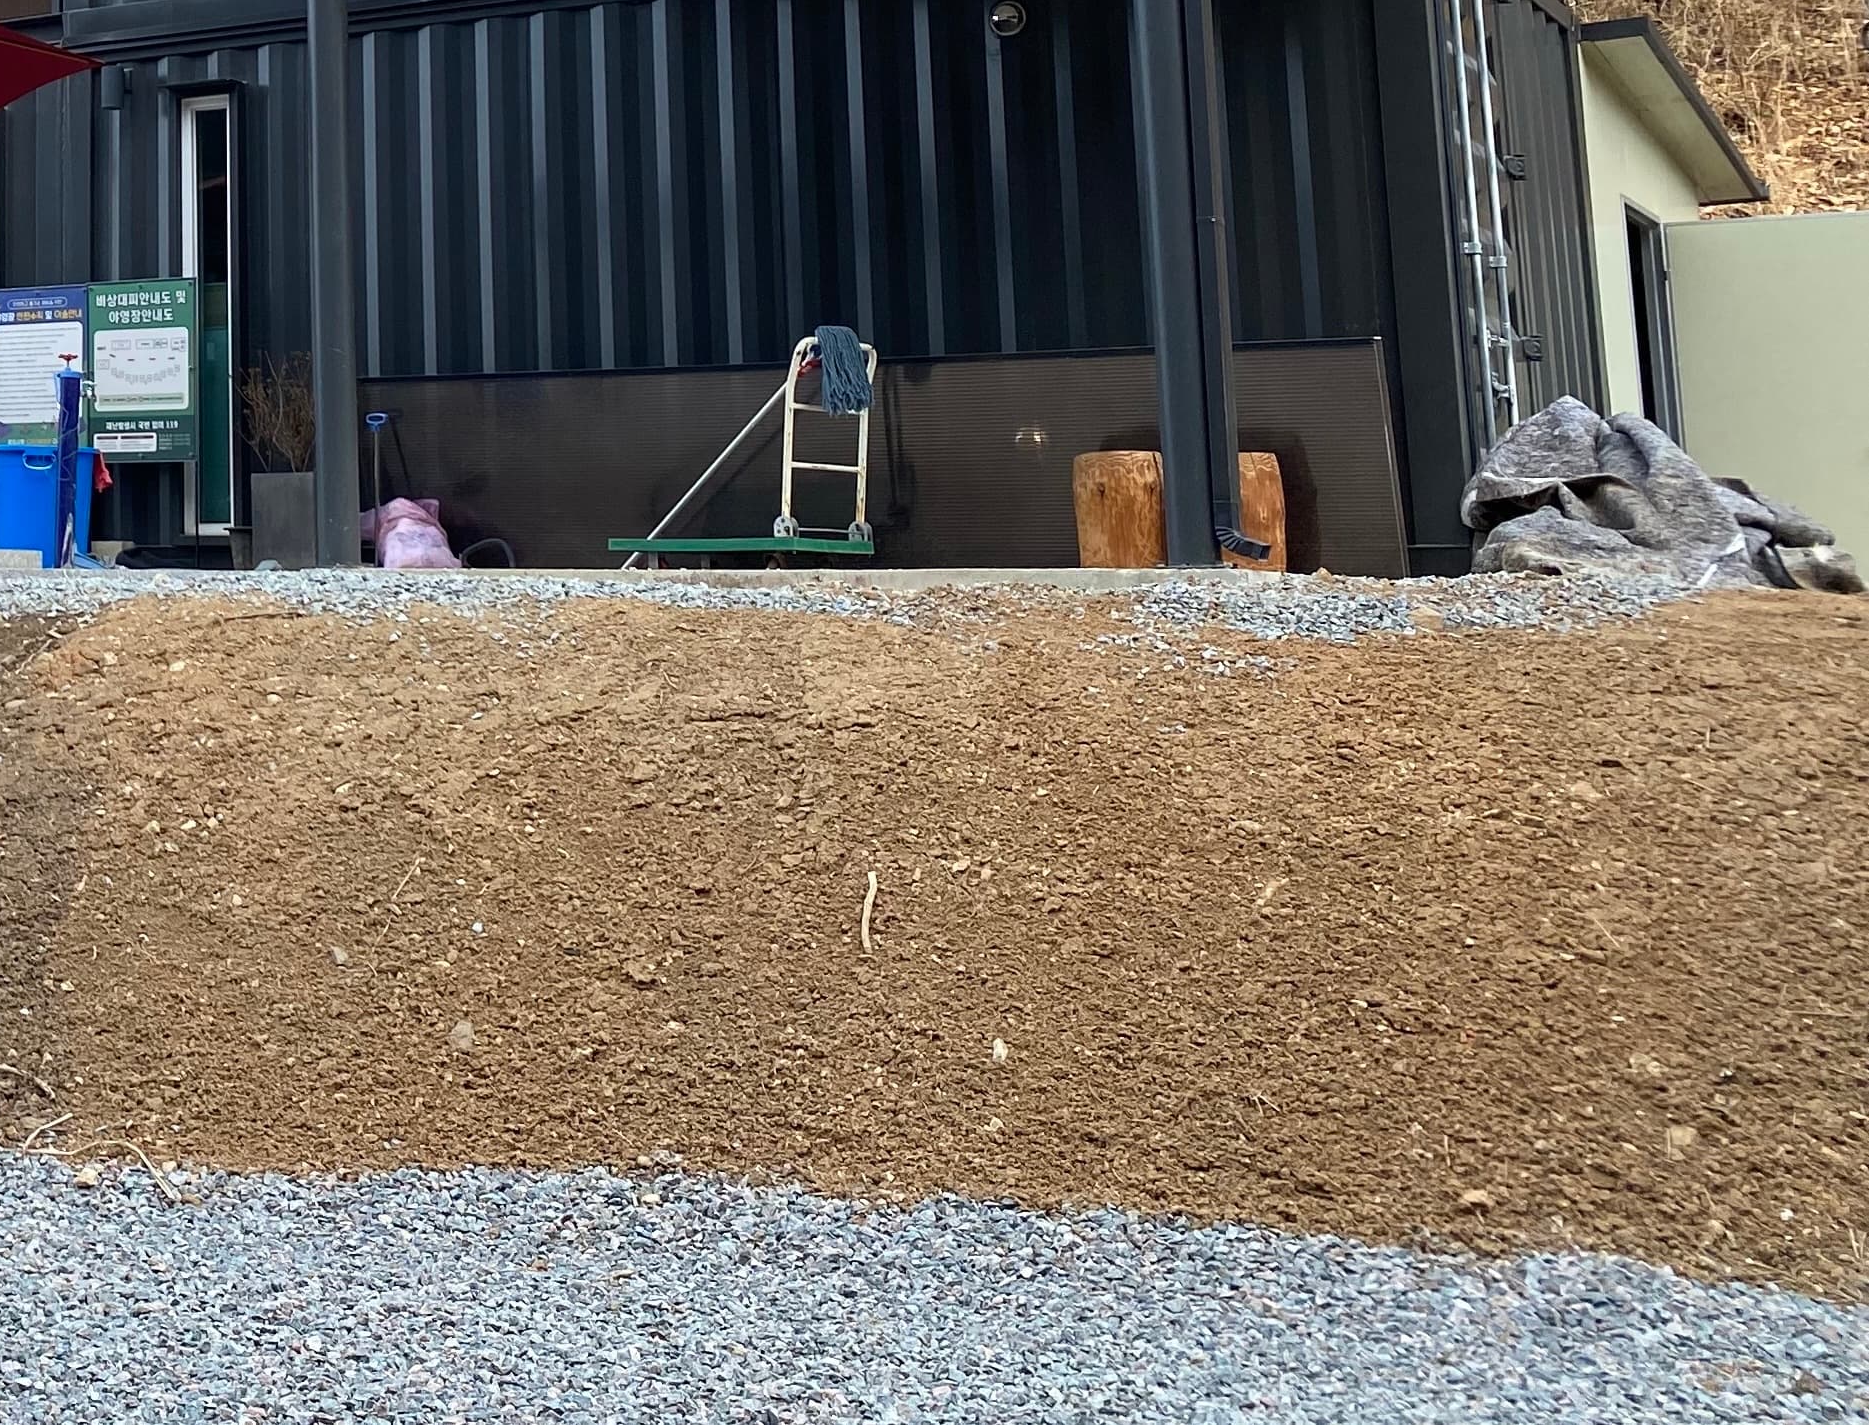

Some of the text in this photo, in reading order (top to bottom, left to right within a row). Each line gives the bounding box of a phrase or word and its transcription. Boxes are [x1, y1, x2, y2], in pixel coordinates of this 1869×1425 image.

[95, 290, 186, 307] 비상대피안내도 및
[44, 310, 53, 320] 및
[108, 308, 174, 324] 야영장안내도
[165, 420, 179, 429] 119
